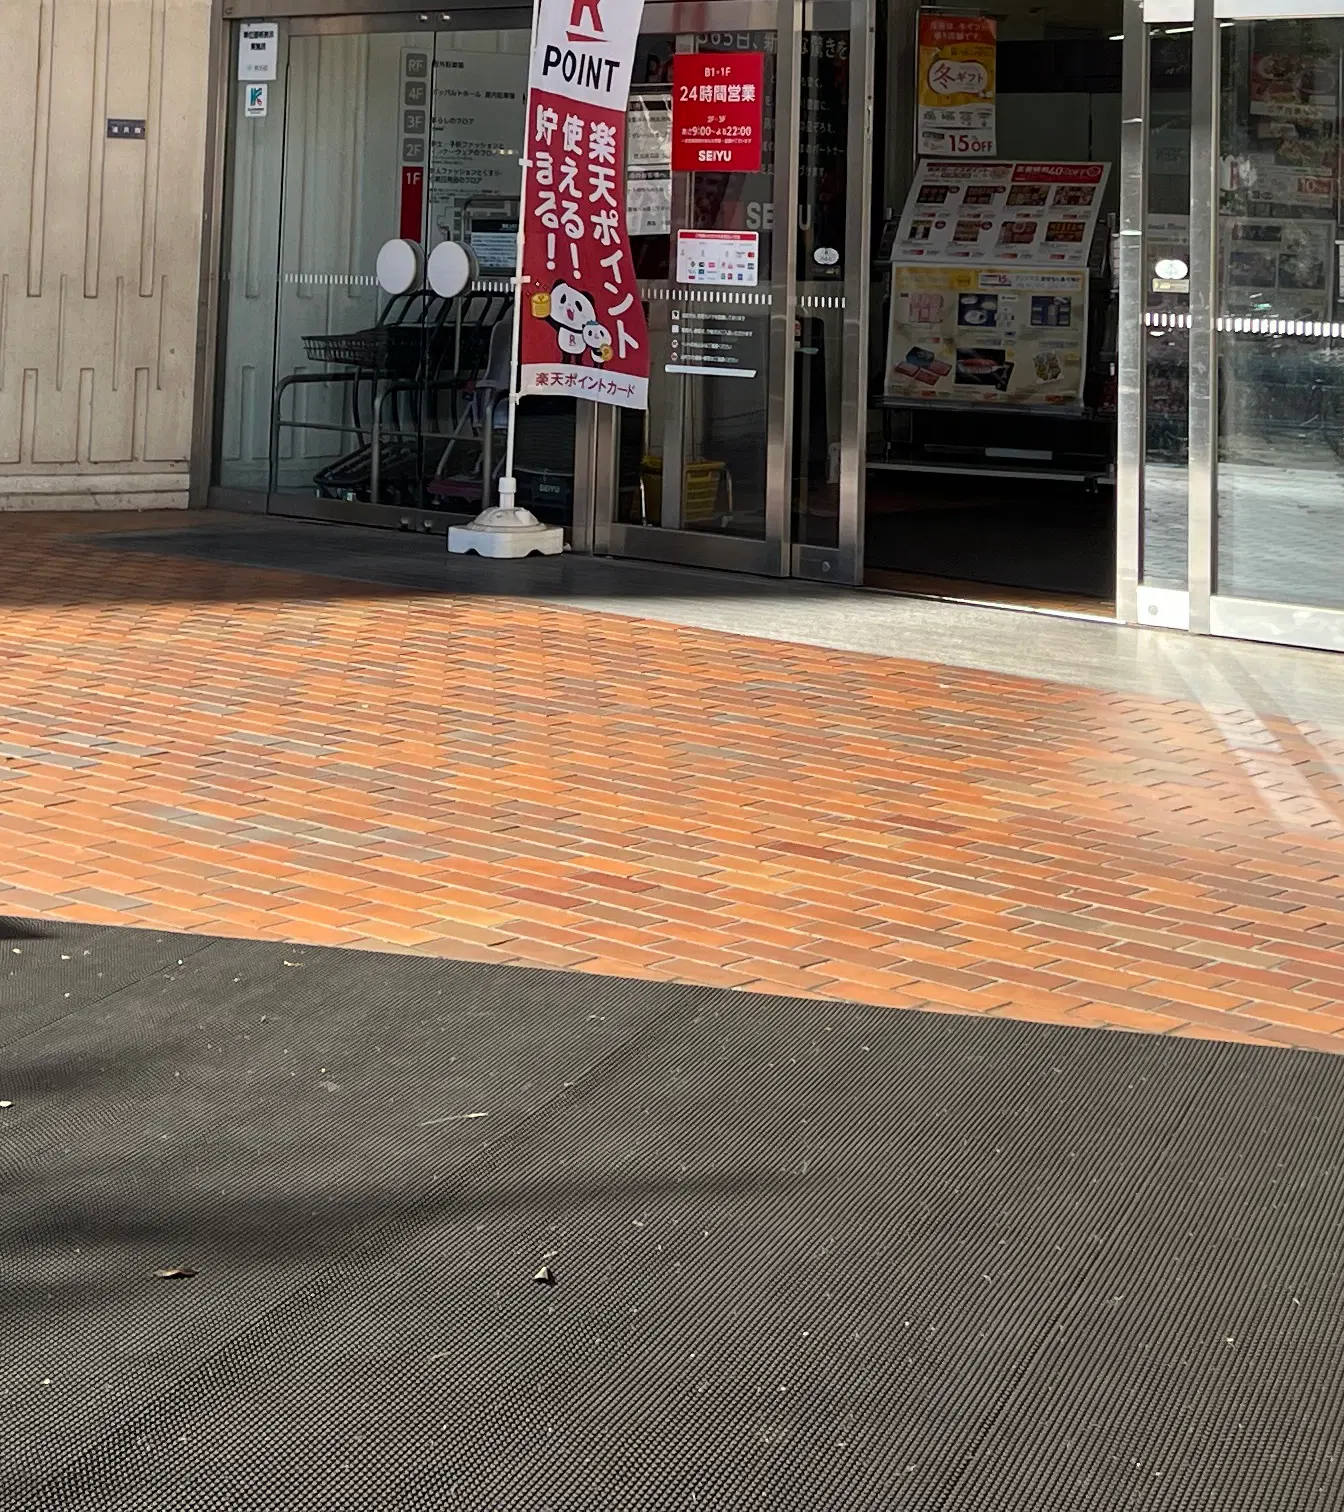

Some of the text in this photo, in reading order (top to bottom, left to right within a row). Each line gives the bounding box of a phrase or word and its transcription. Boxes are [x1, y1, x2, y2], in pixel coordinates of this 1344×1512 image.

[542, 44, 621, 93] POINT
[407, 87, 424, 100] 4F
[679, 84, 756, 103] 24時間営業
[407, 115, 424, 128] 3F
[406, 143, 422, 157] 2F
[698, 150, 732, 162] SEIYU
[406, 172, 422, 185] 1F
[588, 121, 640, 359] 楽天ポイント
[536, 372, 636, 399] 楽天ポイントカード
